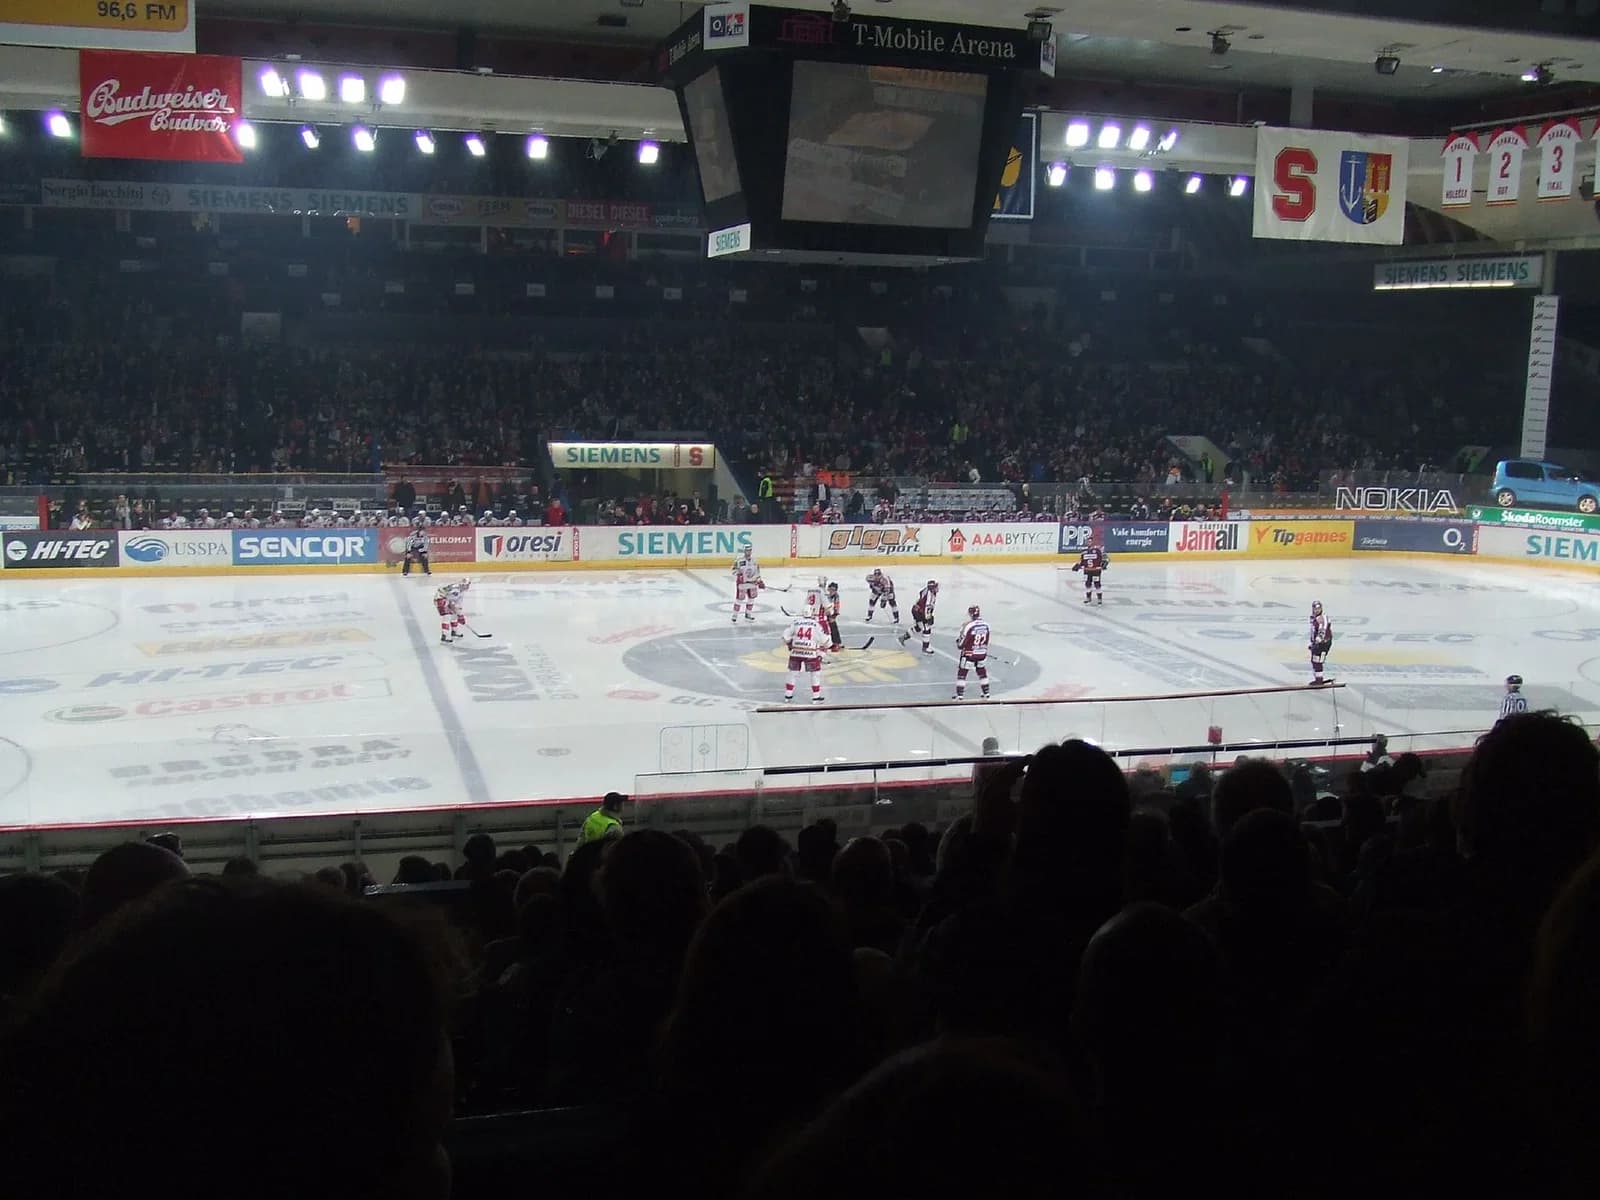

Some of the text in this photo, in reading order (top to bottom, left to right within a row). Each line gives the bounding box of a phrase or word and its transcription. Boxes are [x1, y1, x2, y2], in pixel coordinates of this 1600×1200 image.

[97, 1, 177, 22] 96,6 FM
[853, 22, 1017, 58] T-Mobile Arena
[86, 78, 235, 120] Budweiser
[149, 107, 232, 133] Budvar
[1455, 157, 1462, 183] 1
[1500, 151, 1512, 179] 2
[1551, 145, 1564, 174] 3
[1272, 146, 1318, 222] S
[187, 188, 292, 208] SIEMENS
[308, 193, 409, 214] SIEMENS
[567, 203, 605, 220] DIESEL
[610, 205, 649, 222] DIESEL
[715, 229, 743, 252] SIEMENS
[1384, 261, 1530, 286] SIEMENS SIEMENS
[566, 447, 661, 464] SIEMENS
[1335, 486, 1458, 514] NOKIA
[31, 540, 110, 560] HI-TEC
[173, 541, 229, 557] USSPA
[239, 536, 367, 559] SENCOR
[506, 531, 562, 553] oresi
[618, 530, 753, 557] SIEMENS
[877, 543, 921, 555] sport
[1176, 523, 1239, 552] Jamall
[1272, 528, 1347, 546] Tipgames
[796, 626, 813, 641] 44
[85, 655, 346, 689] HI-TEC
[133, 683, 355, 718] Castrol
